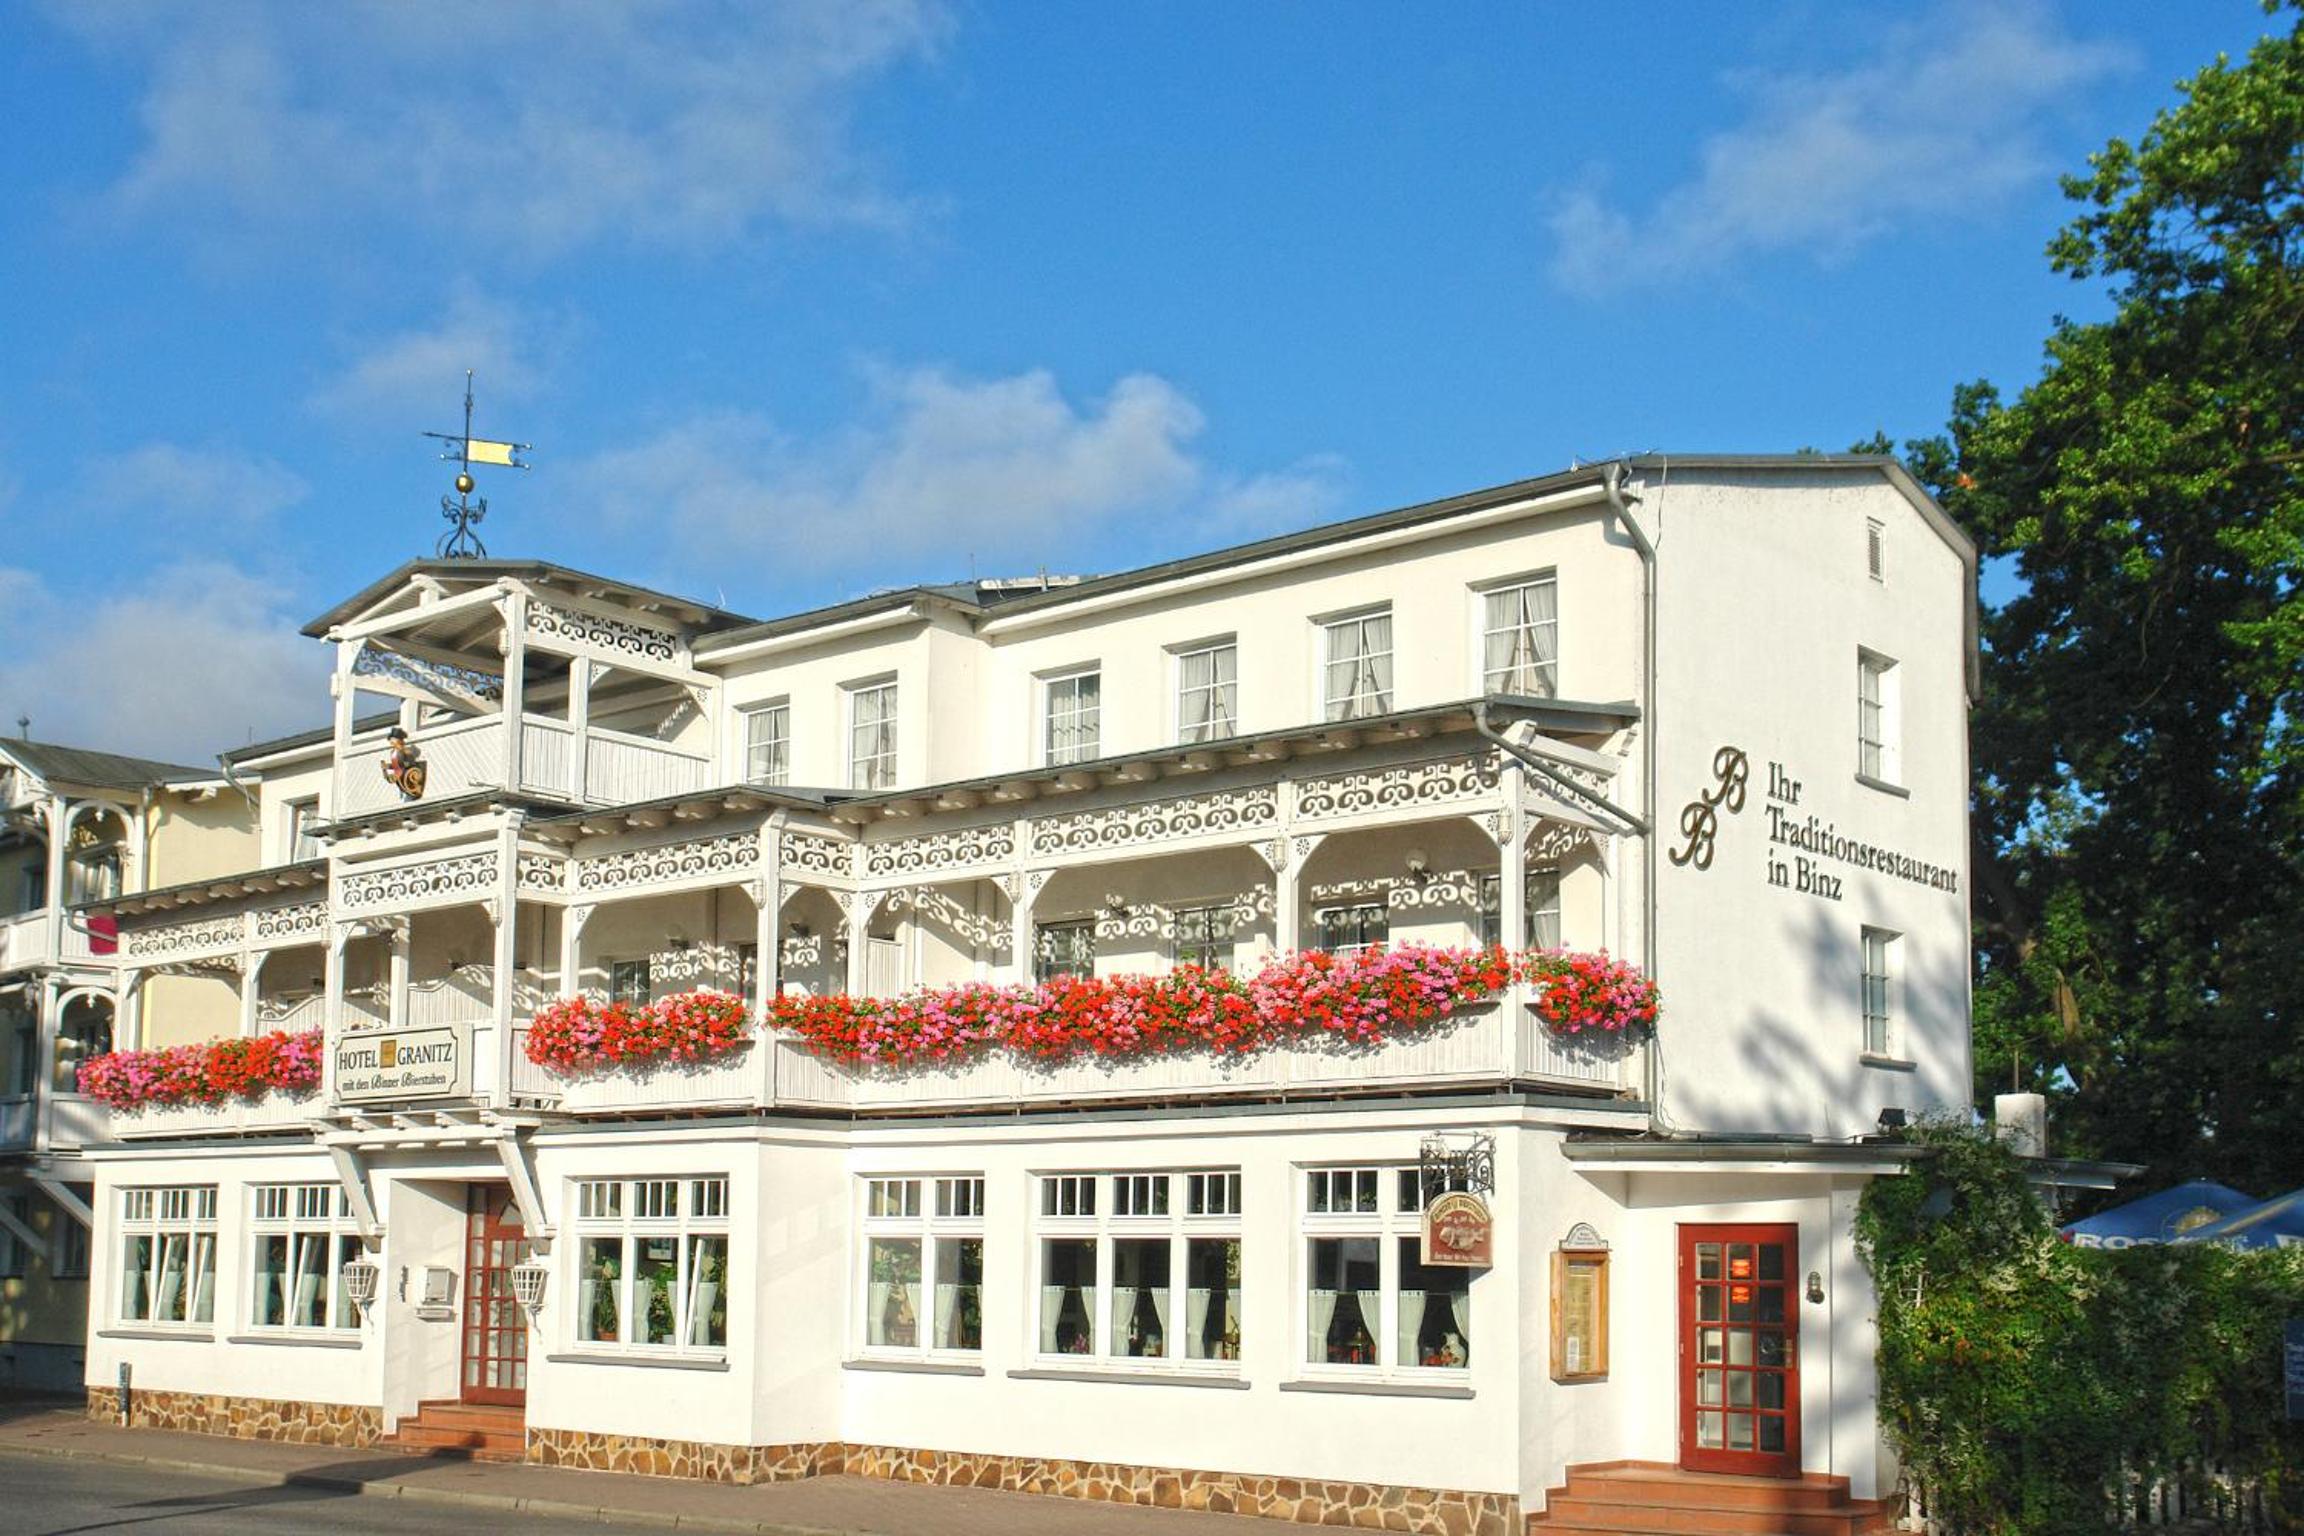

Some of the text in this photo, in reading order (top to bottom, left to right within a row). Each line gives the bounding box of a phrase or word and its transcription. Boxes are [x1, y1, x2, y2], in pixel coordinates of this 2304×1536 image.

[1767, 761, 1802, 805] Ihr
[1765, 804, 1958, 894] Traditionsrestaurant
[1767, 848, 1842, 900] in Binz
[339, 1043, 452, 1070] HOTEL GRANITZ
